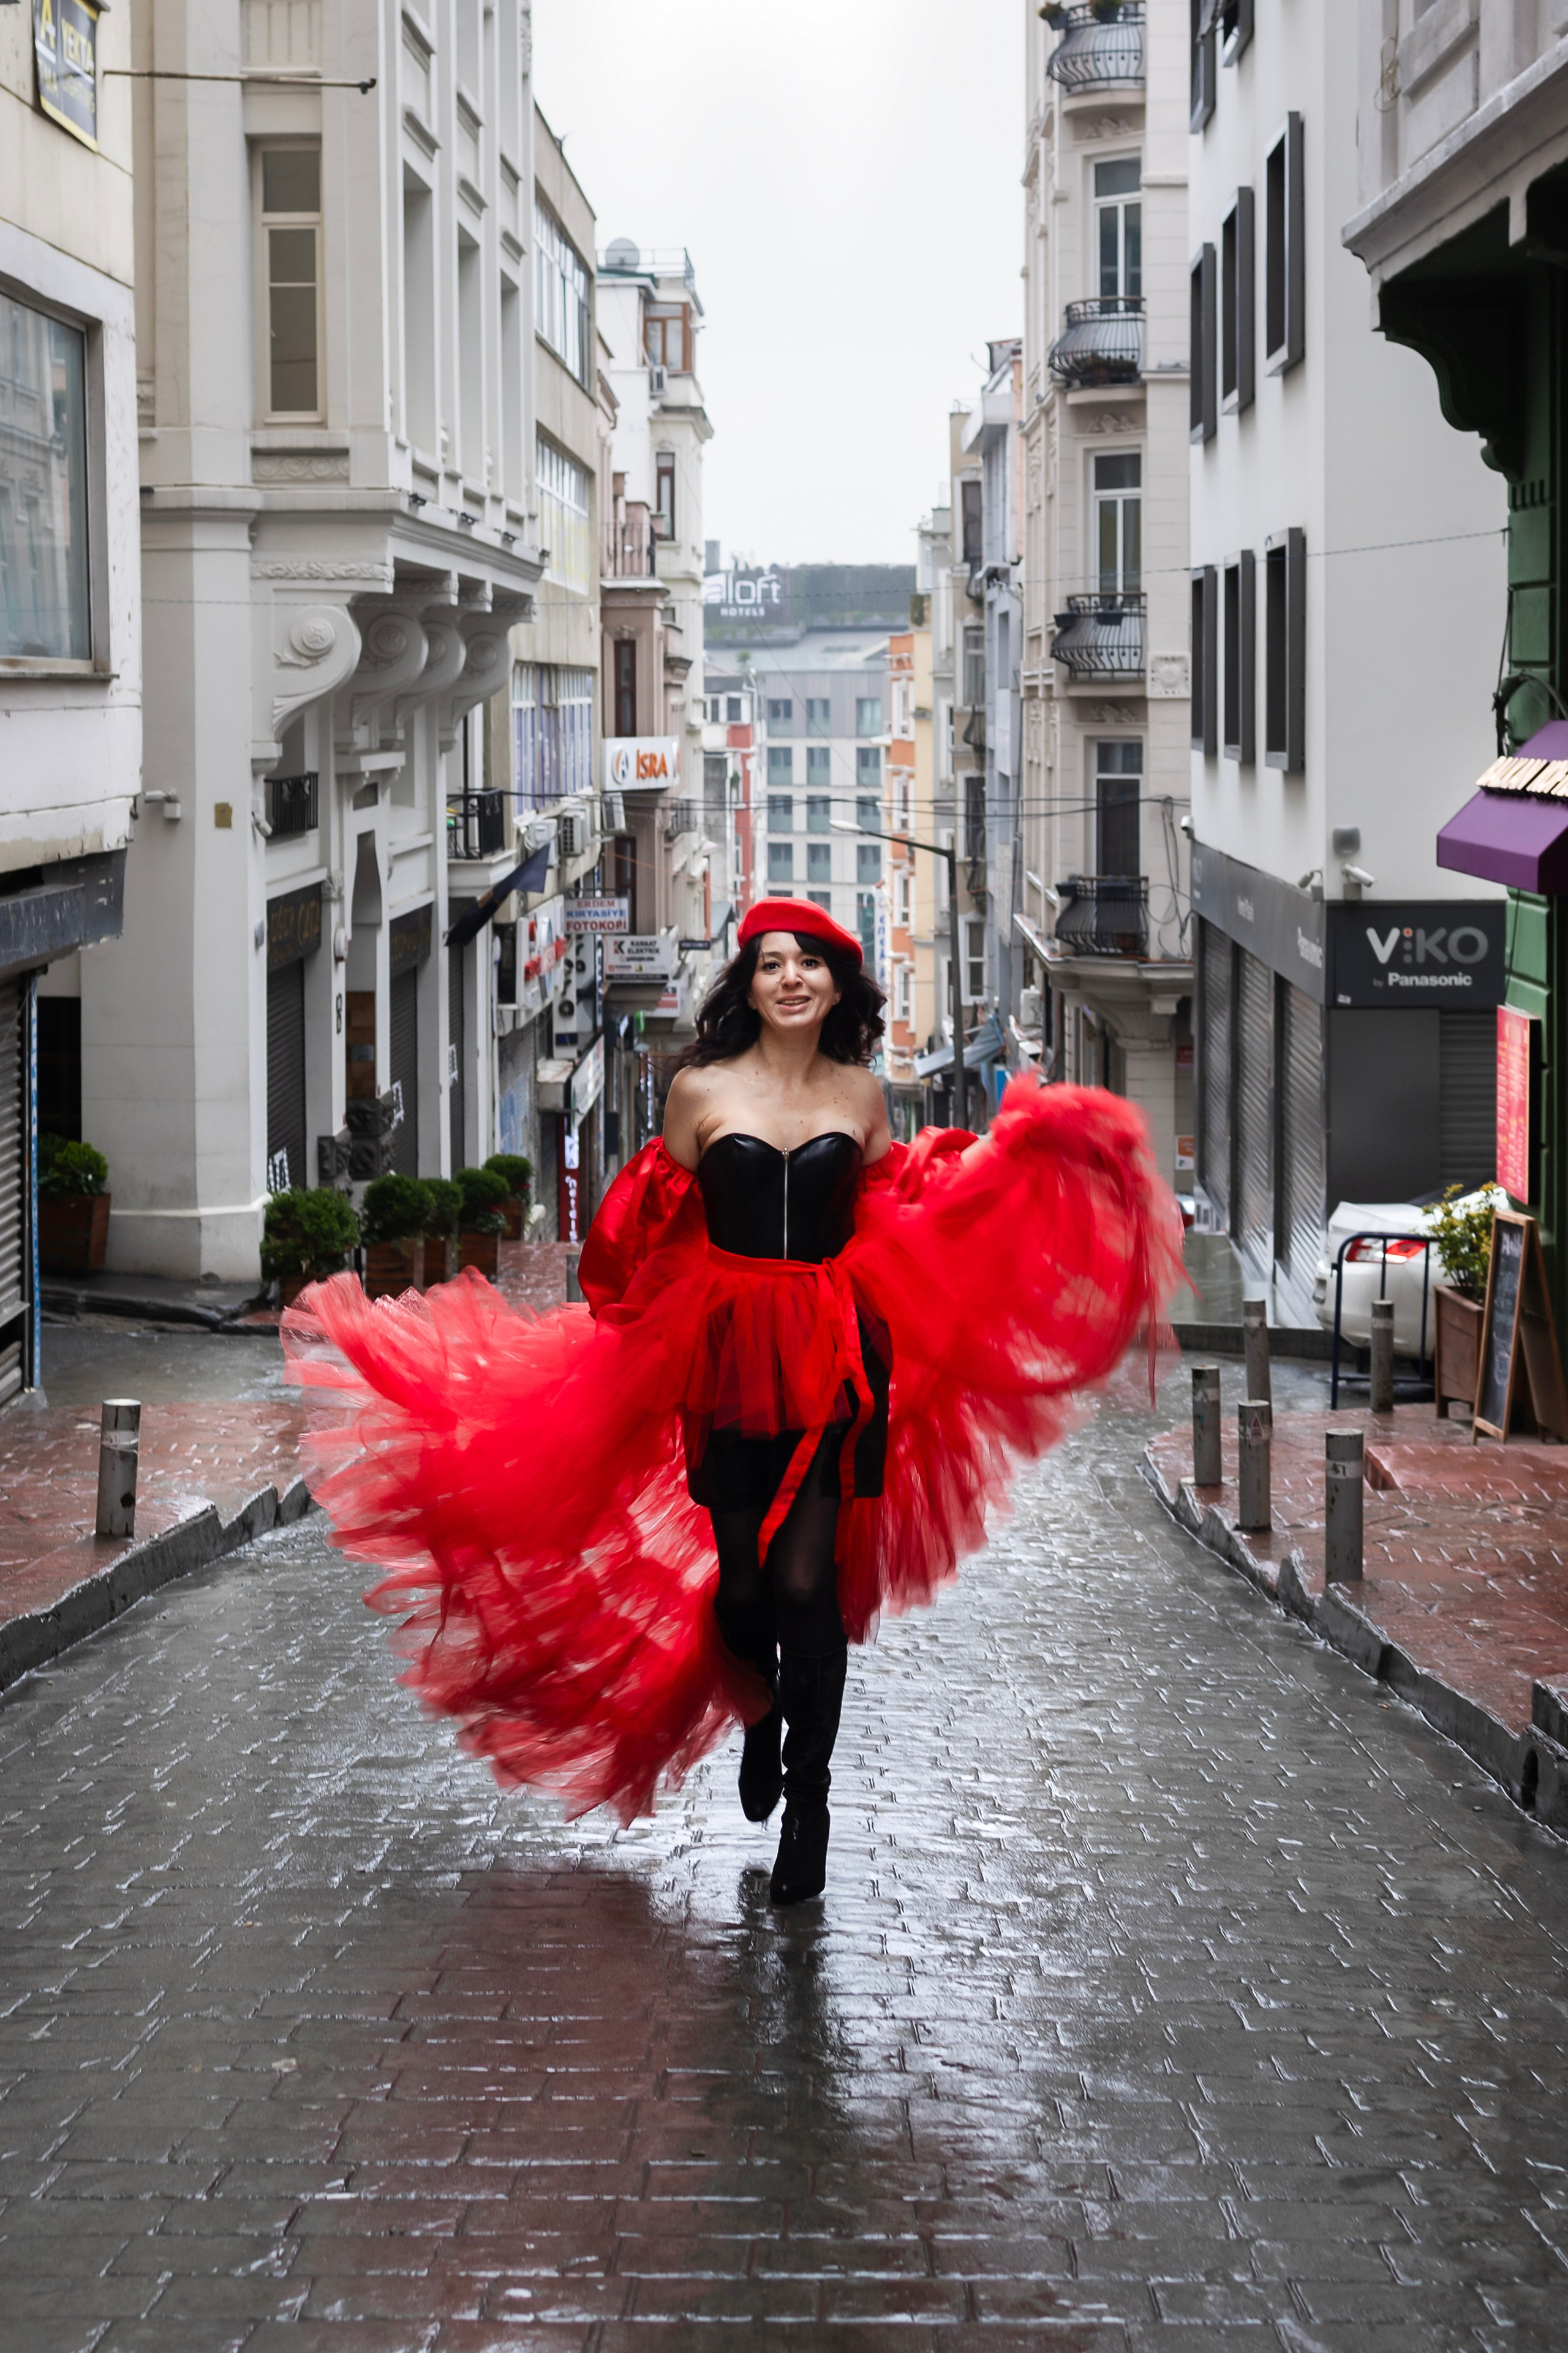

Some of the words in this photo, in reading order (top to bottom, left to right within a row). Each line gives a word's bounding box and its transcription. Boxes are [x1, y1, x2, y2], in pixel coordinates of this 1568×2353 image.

[62, 18, 94, 77] YEKTA
[700, 572, 782, 605] aloft
[720, 607, 765, 617] HOTELS
[1388, 972, 1472, 986] Panasonic
